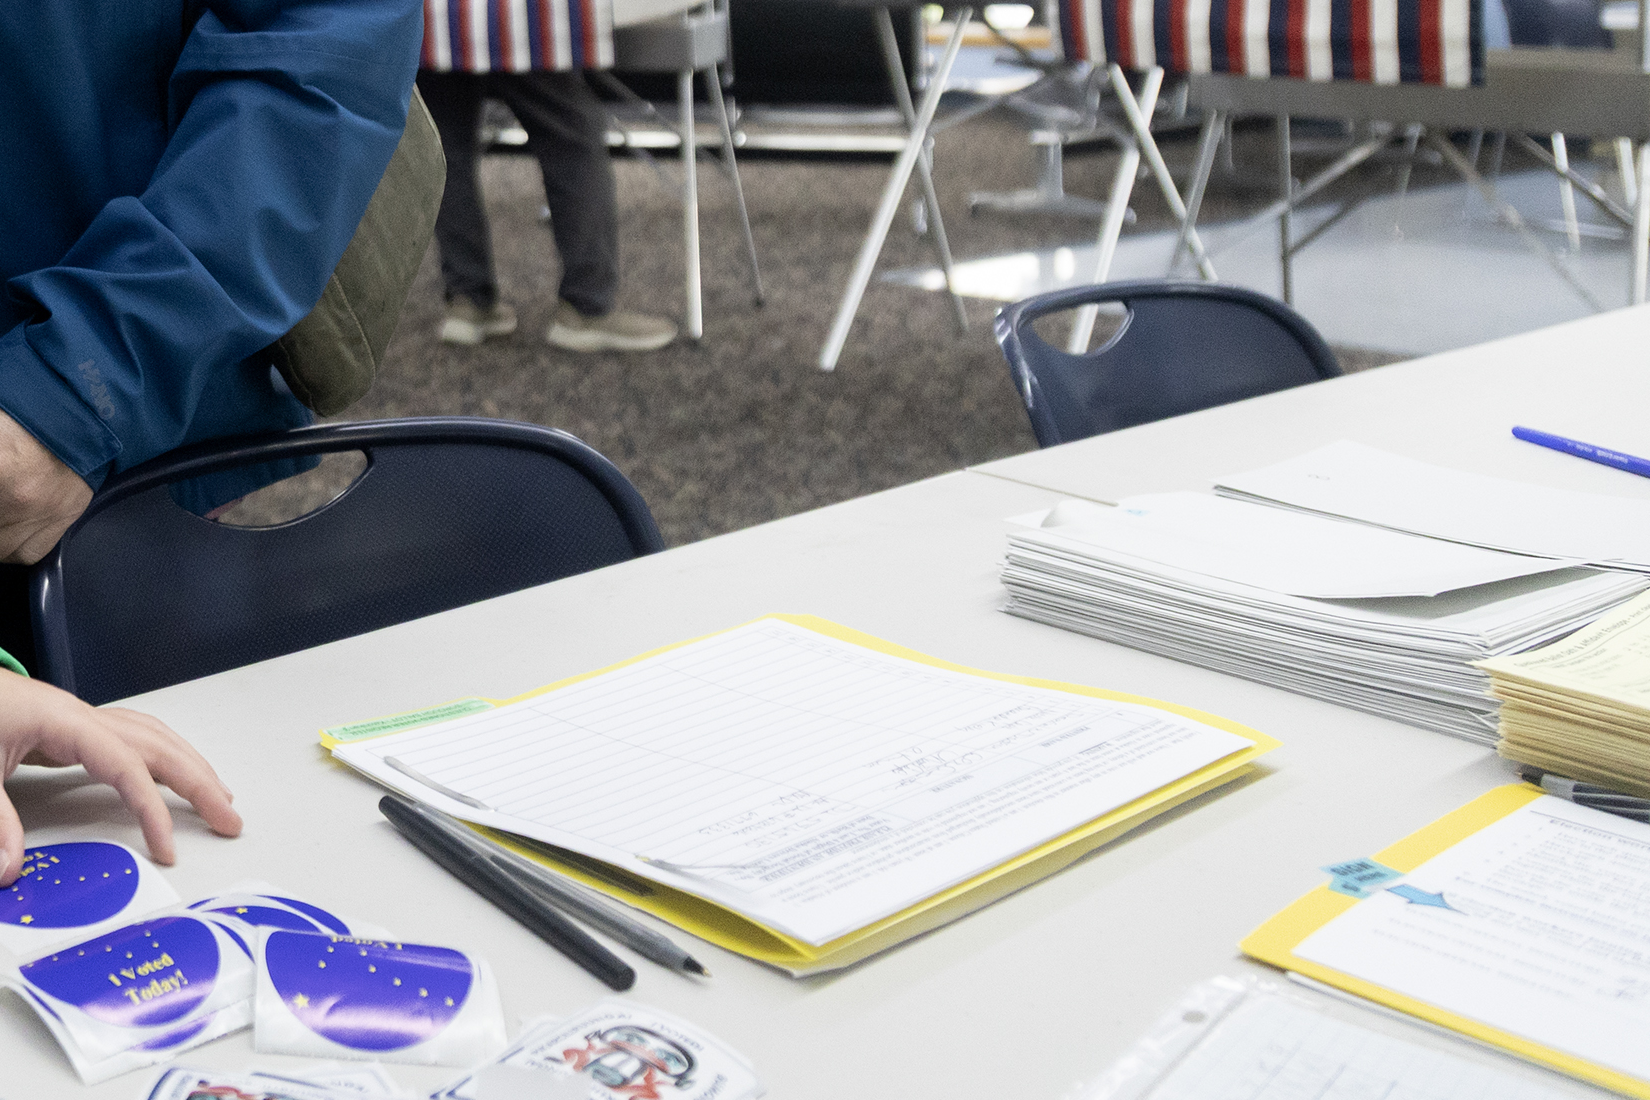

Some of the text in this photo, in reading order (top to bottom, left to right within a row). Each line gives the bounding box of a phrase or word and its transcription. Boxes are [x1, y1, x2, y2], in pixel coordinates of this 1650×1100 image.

[108, 952, 175, 987] I Voted
[124, 968, 189, 1006] Today!
